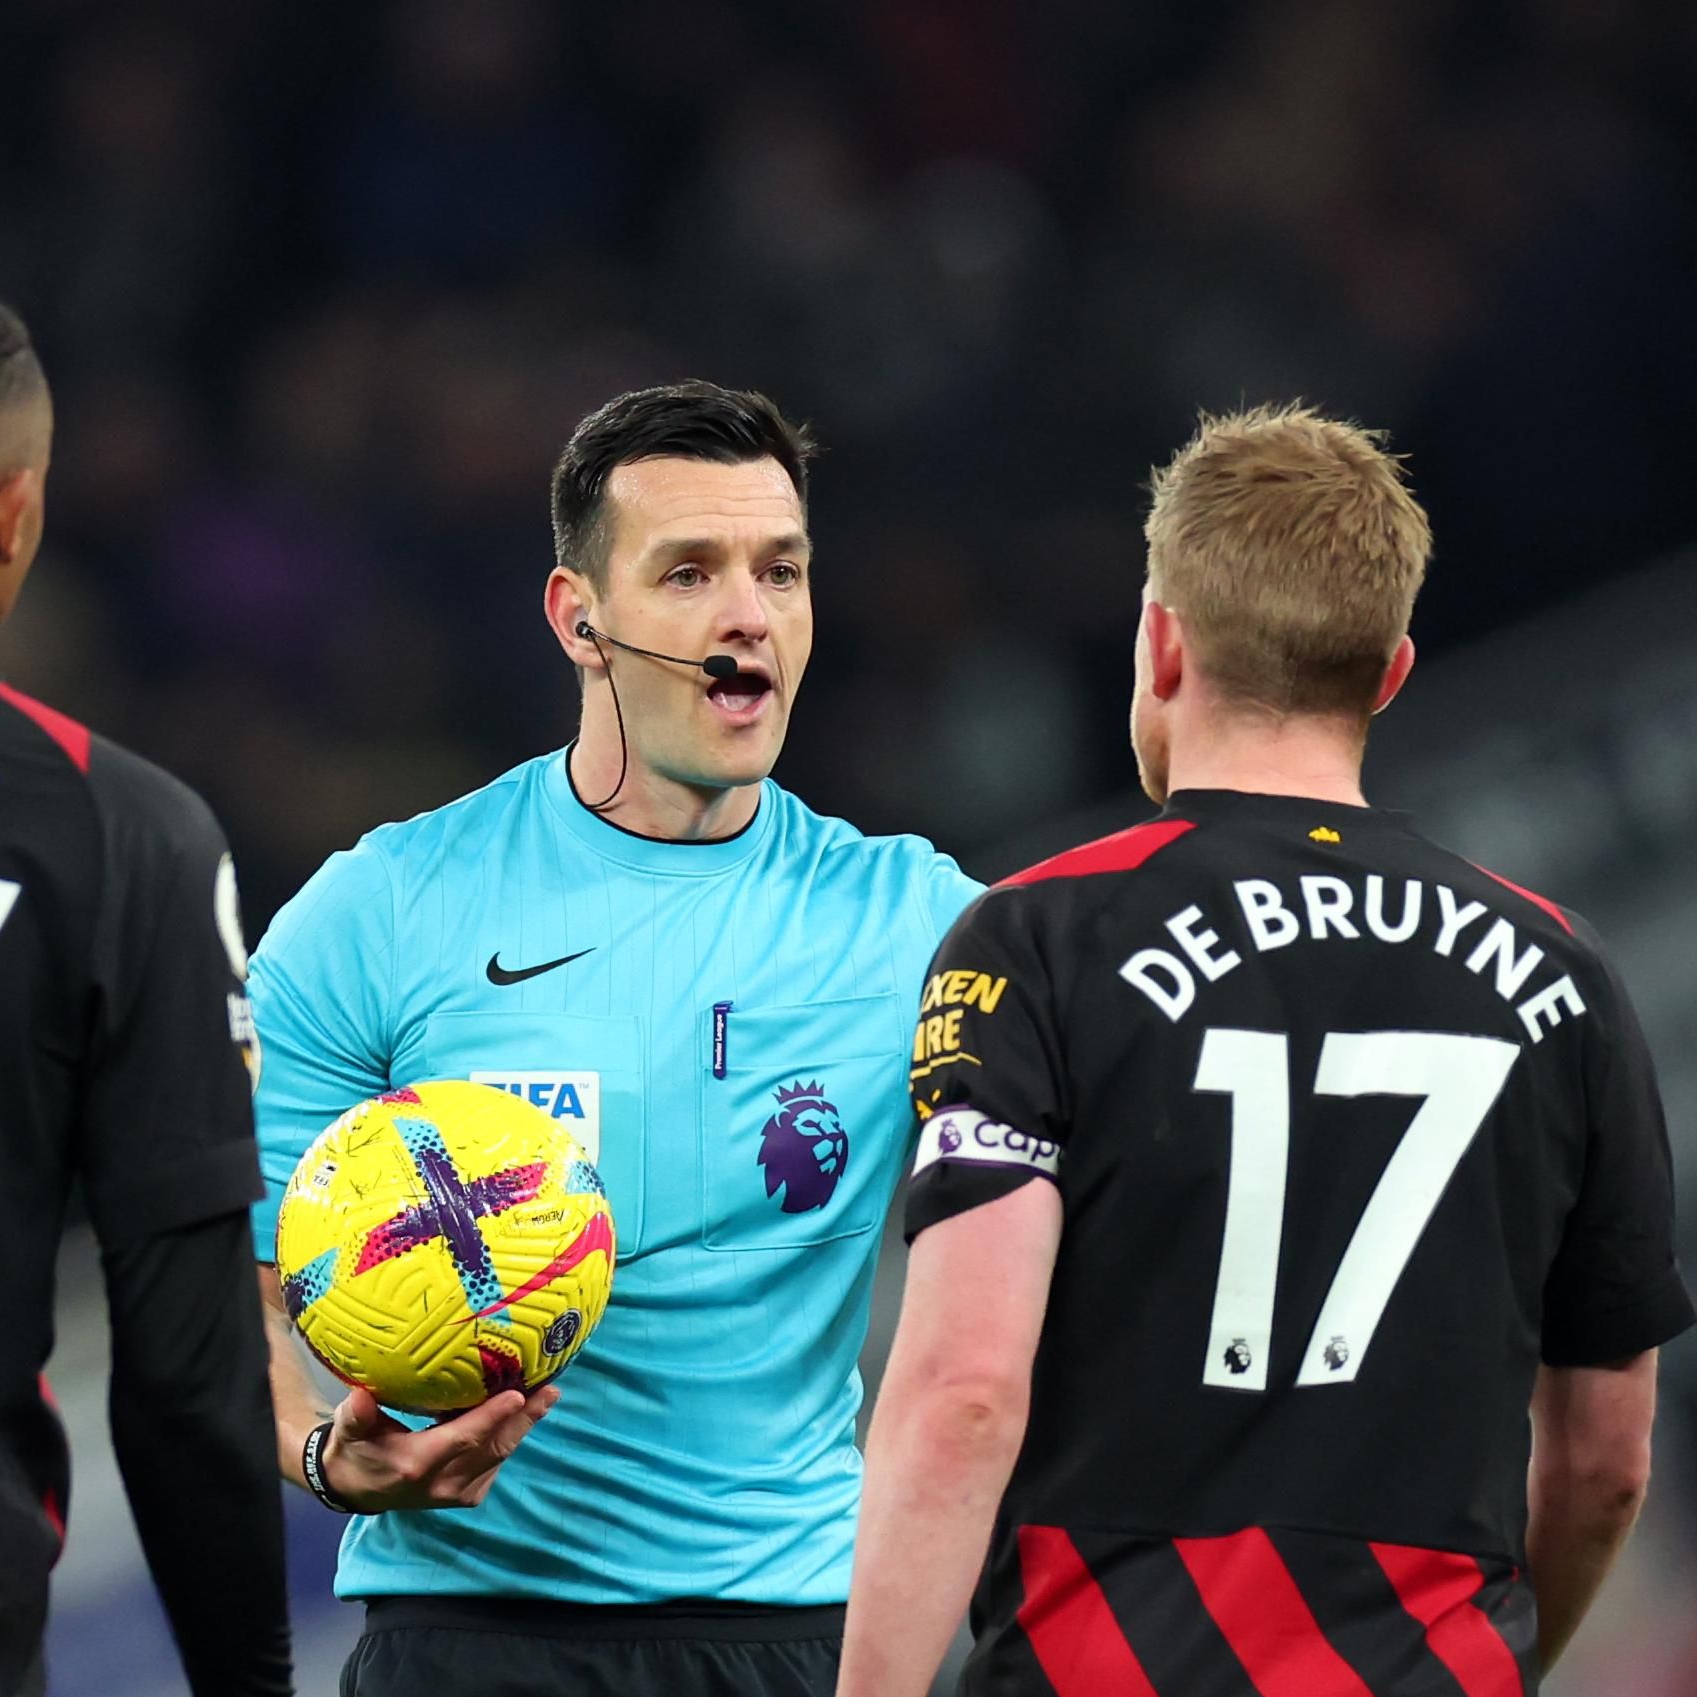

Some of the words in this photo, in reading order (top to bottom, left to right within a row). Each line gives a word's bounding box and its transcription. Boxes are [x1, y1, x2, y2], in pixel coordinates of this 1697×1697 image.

[1118, 903, 1242, 1022] DE
[1232, 874, 1586, 1045] BRUYNE
[921, 968, 1008, 1015] XEN
[714, 1014, 725, 1042] League
[974, 1116, 1061, 1163] Cap
[1191, 1025, 1522, 1392] 17
